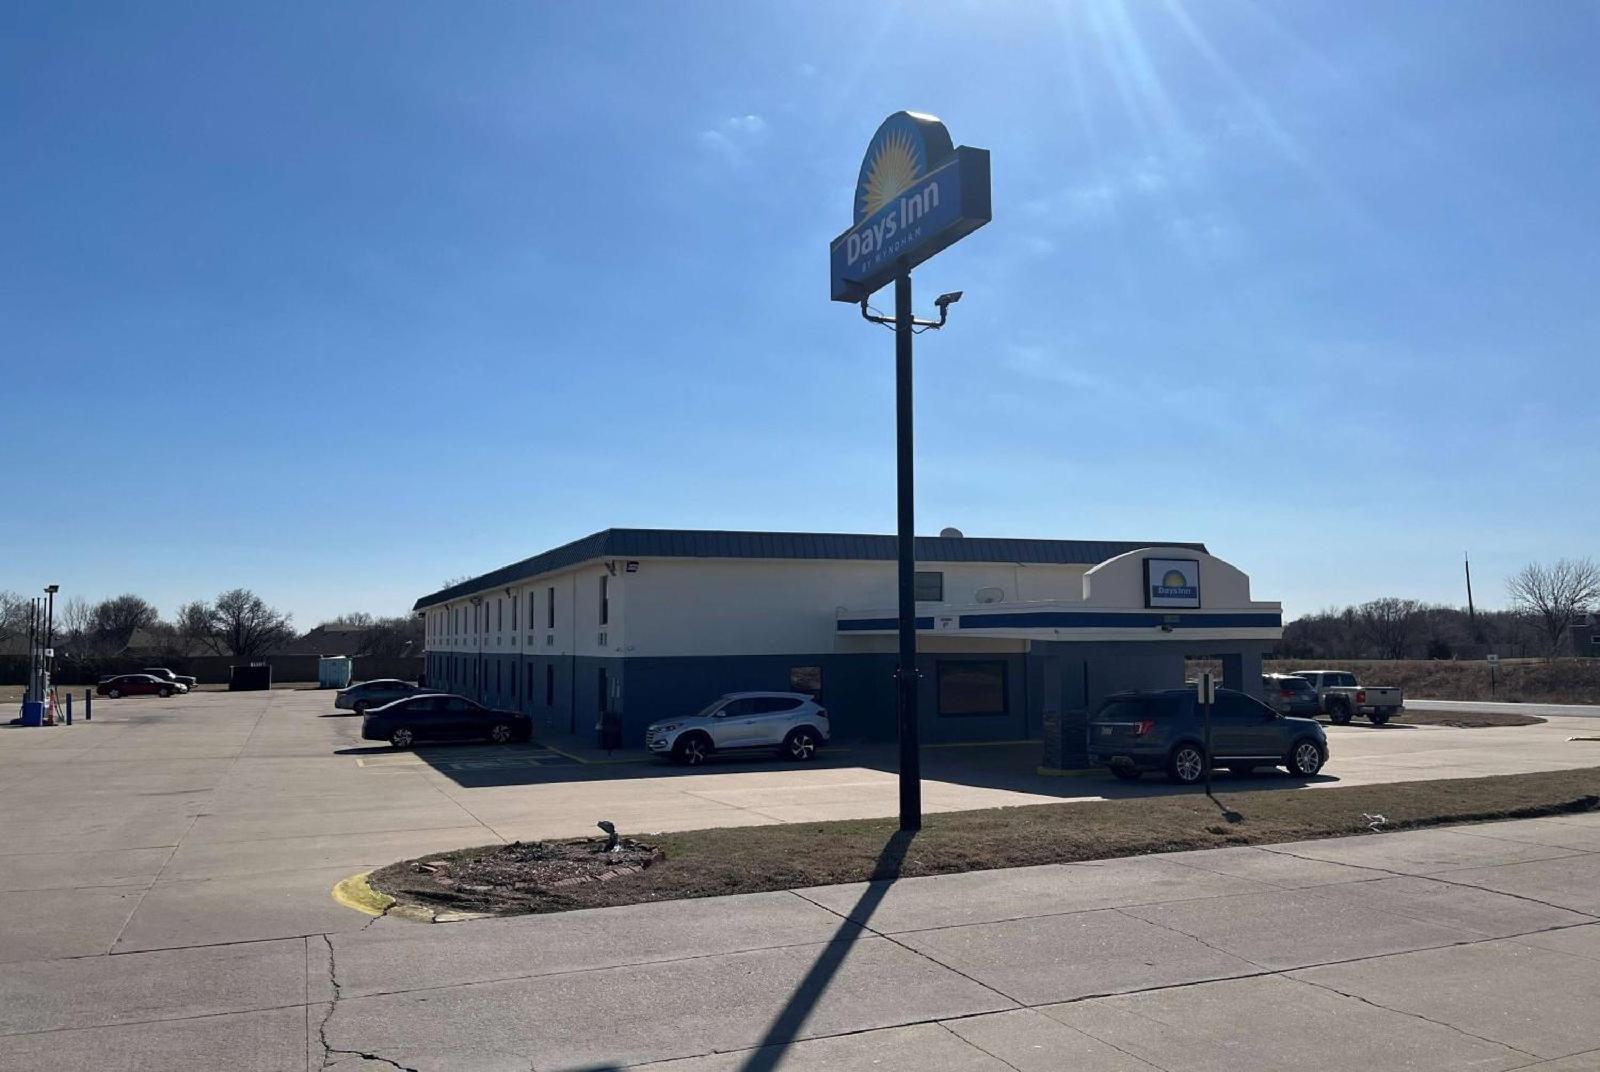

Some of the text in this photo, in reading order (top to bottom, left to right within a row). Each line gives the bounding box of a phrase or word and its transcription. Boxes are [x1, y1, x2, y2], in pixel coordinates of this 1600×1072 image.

[847, 182, 939, 266] Days Inn
[1158, 587, 1177, 597] Days
